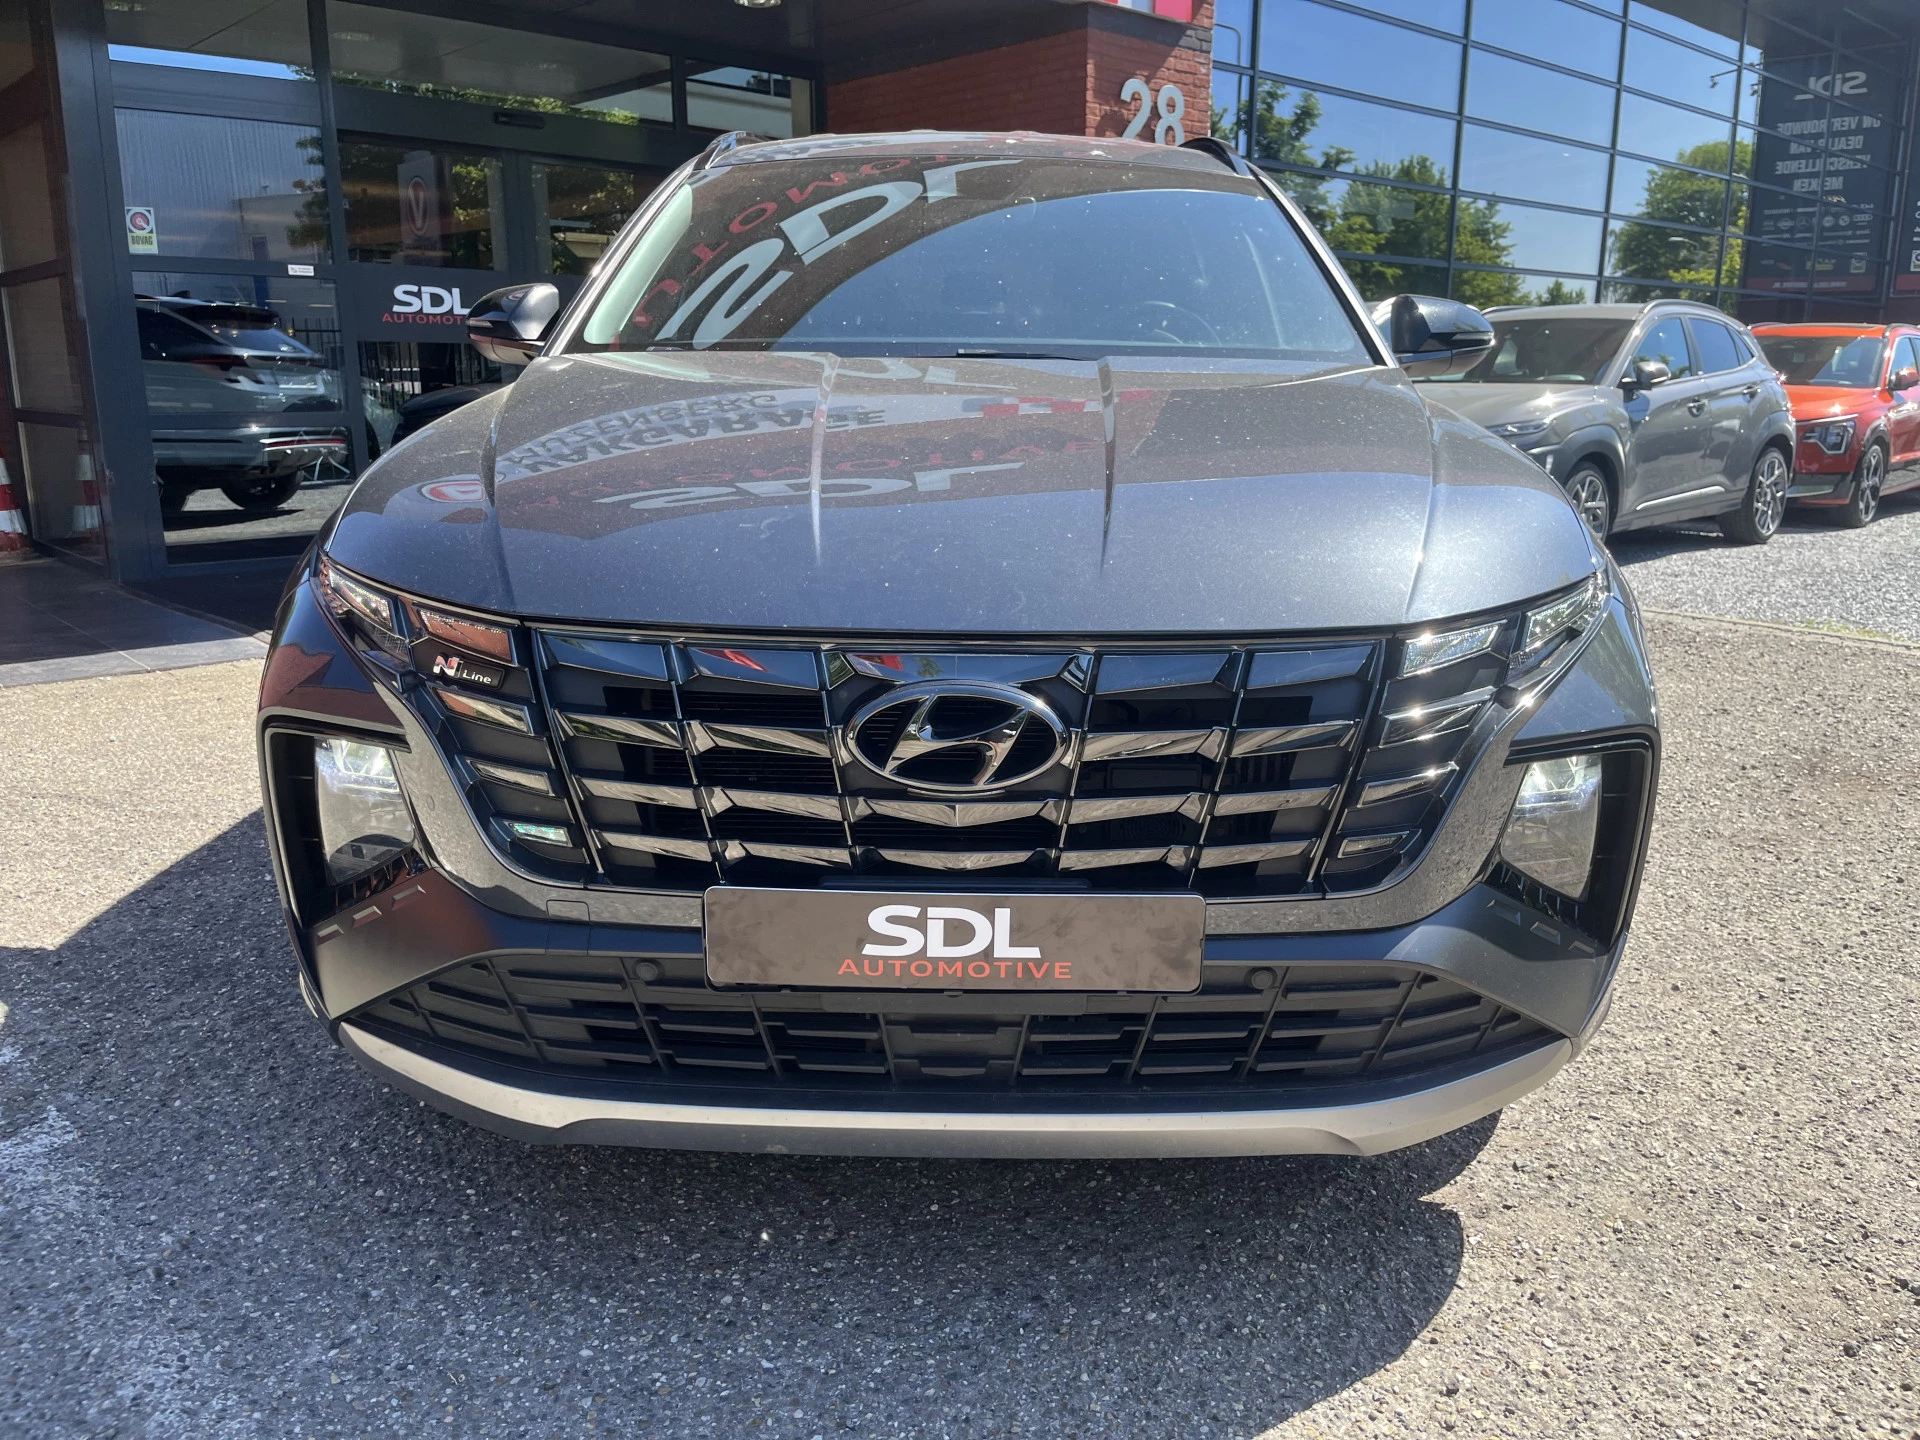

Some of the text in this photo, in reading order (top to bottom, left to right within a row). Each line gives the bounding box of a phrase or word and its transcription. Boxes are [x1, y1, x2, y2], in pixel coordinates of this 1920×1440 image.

[1120, 78, 1185, 147] 28
[131, 234, 154, 246] BOVAG
[392, 284, 471, 316] SDL
[382, 313, 464, 325] AUTOMOT
[433, 655, 492, 684] N Line
[861, 904, 1041, 960] SDL
[837, 957, 1073, 980] AUTOMOTIVE
